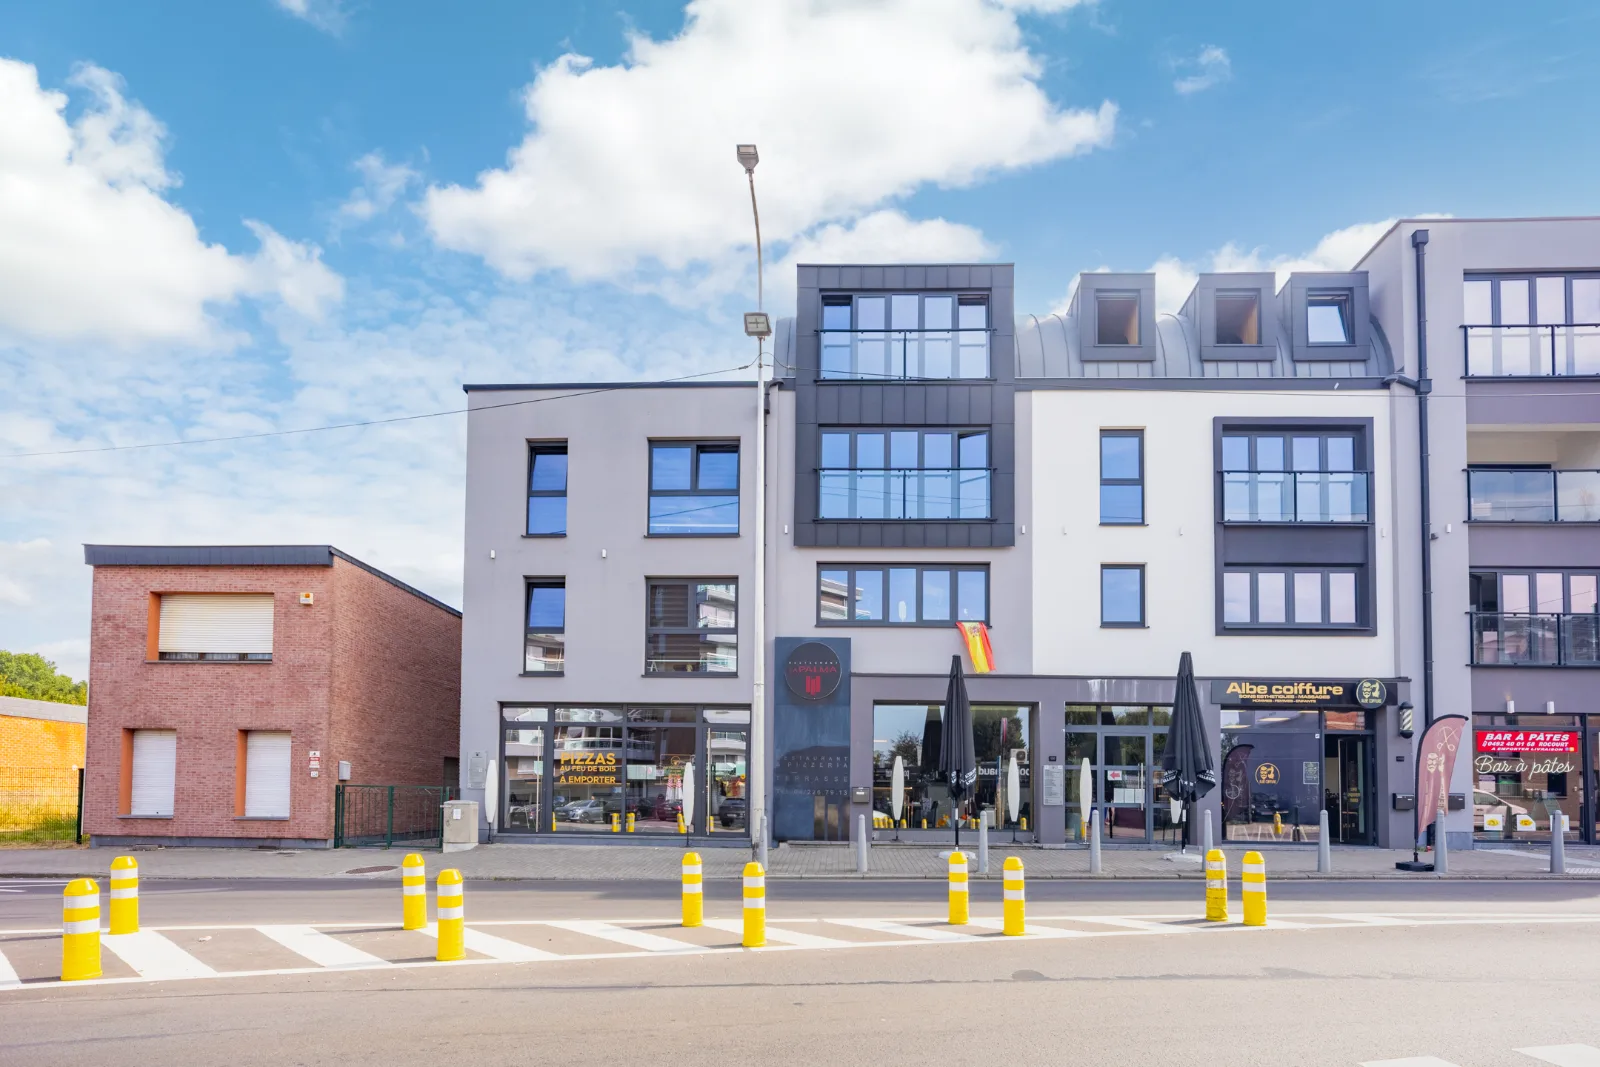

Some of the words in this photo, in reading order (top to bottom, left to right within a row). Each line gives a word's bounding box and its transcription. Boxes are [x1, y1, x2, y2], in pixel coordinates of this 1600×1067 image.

[1226, 682, 1268, 694] Albe
[1271, 682, 1343, 695] coiffure
[1485, 733, 1512, 741] BAR
[1528, 732, 1570, 741] PÂTES
[560, 752, 616, 765] PIZZAS
[1474, 755, 1512, 774] Bar
[1516, 758, 1528, 772] à
[1527, 757, 1575, 780] pâtes
[568, 776, 616, 784] EMPORTER
[776, 775, 848, 783] TERRASSE
